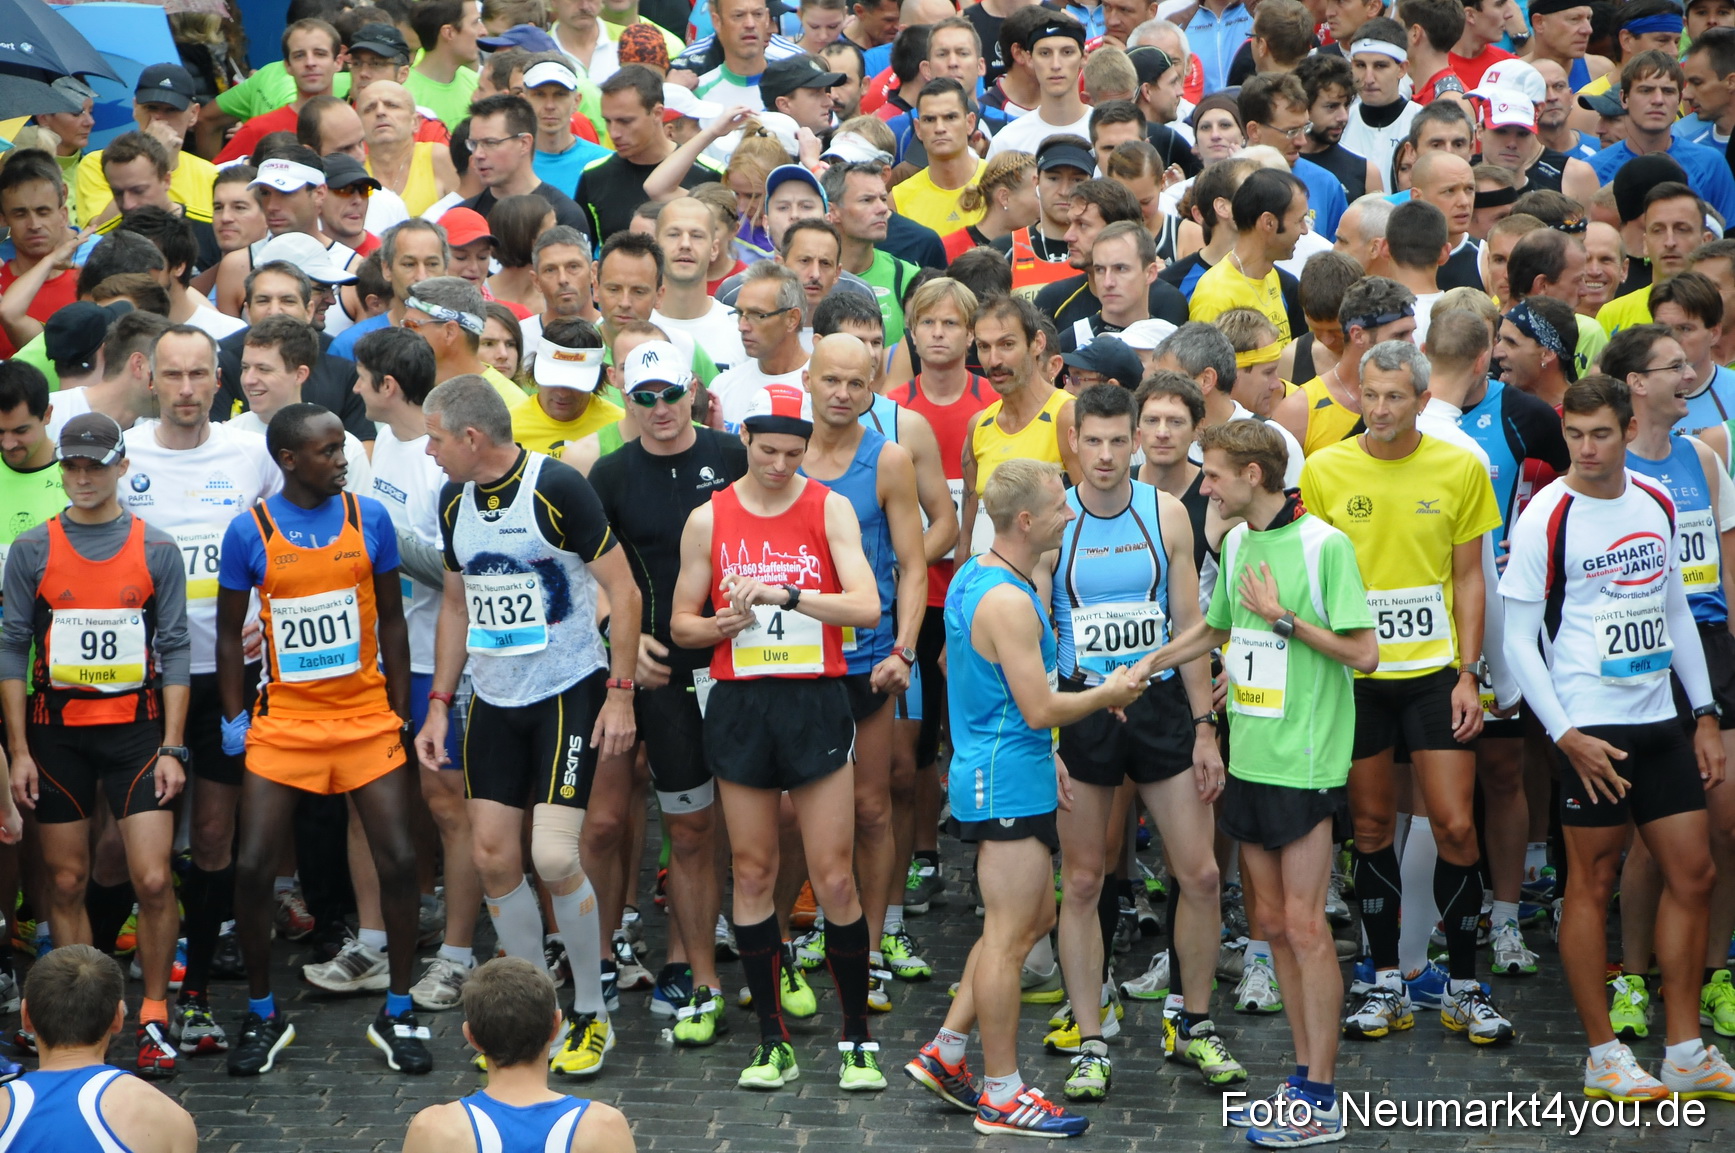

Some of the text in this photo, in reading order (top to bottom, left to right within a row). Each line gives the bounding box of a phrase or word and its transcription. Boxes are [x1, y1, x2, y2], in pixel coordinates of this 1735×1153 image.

[176, 533, 220, 542] Neumarkt
[183, 544, 220, 575] 78
[1583, 542, 1655, 571] GERHART
[738, 564, 757, 576] 1860
[758, 561, 801, 573] Staffelstein
[1585, 555, 1664, 579] Autohaus JÄNIG
[1683, 570, 1705, 583] artin
[466, 582, 522, 592] PARTL Neumarkt
[272, 599, 342, 616] PARTL Neumarkt
[1366, 595, 1434, 607] ARTL Neumarkt
[473, 594, 536, 626] 2132
[1074, 610, 1147, 623] PARTL Neumarkt
[1595, 604, 1660, 623] PARTL Neumarkt
[55, 617, 127, 626] PARTL Neumarkt
[281, 610, 352, 649] 2001
[767, 611, 785, 640] 4
[1378, 607, 1434, 639] 539
[1084, 618, 1156, 652] 2000
[1242, 638, 1273, 648] Neumarkt
[1605, 617, 1666, 655] 2002
[81, 630, 117, 660] 98
[299, 653, 346, 668] Zachary
[763, 650, 789, 661] Uwe
[1244, 651, 1253, 681] 1
[1630, 660, 1651, 673] Felix
[80, 669, 116, 683] Hynek
